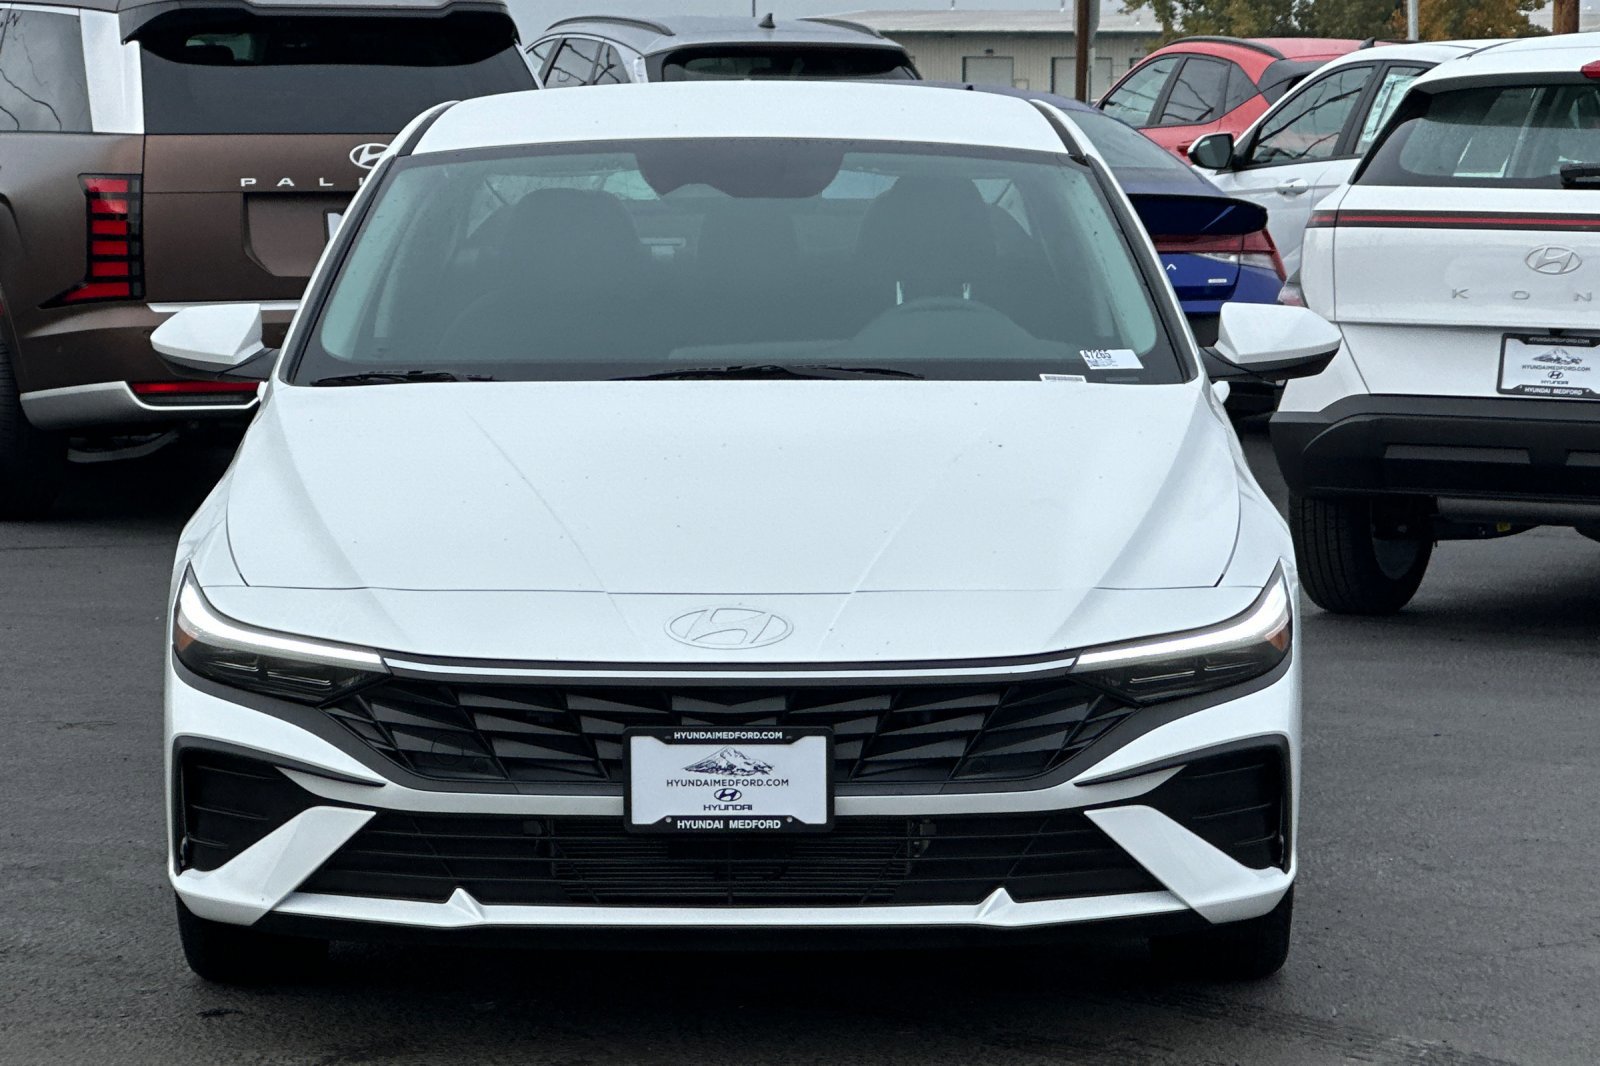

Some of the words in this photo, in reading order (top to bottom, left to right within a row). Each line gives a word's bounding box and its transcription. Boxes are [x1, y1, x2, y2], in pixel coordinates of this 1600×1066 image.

[1521, 364, 1591, 372] HYUNDAIMEDFORD.COM
[666, 779, 789, 787] HYUNDAIMEDFORD.COM
[677, 820, 724, 829] HYUNDAI
[729, 820, 781, 829] MEDFORD
